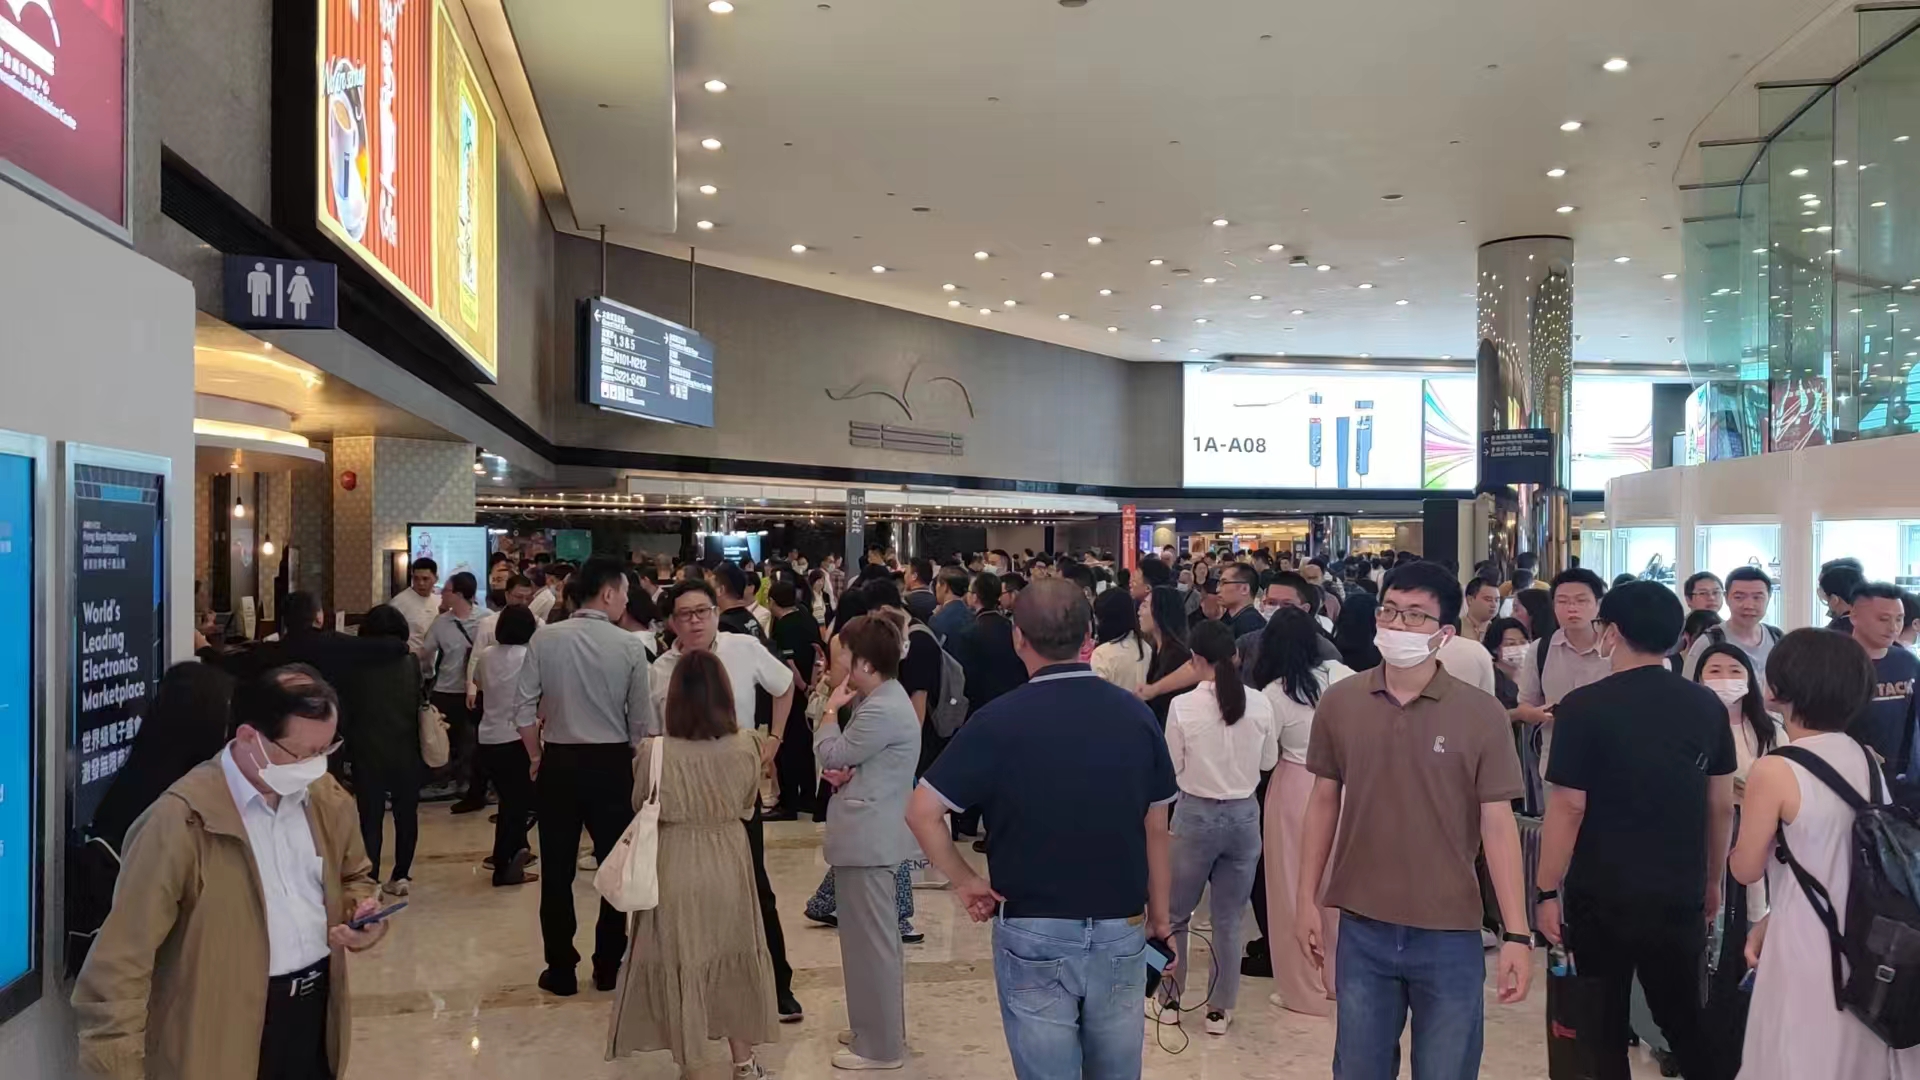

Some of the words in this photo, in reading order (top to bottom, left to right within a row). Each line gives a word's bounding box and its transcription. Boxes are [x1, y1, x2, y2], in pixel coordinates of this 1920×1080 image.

[620, 335, 625, 347] 3
[625, 337, 630, 349] &
[631, 339, 635, 351] 5
[614, 350, 647, 371] N101-N212
[614, 371, 647, 388] S221-S430
[1193, 436, 1267, 453] 1A-A08
[851, 509, 862, 534] Exit
[83, 599, 121, 625] World's
[82, 628, 125, 655] Leading
[82, 653, 139, 683] Electronics
[82, 679, 146, 713] Marketplace
[1875, 681, 1914, 697] TACK
